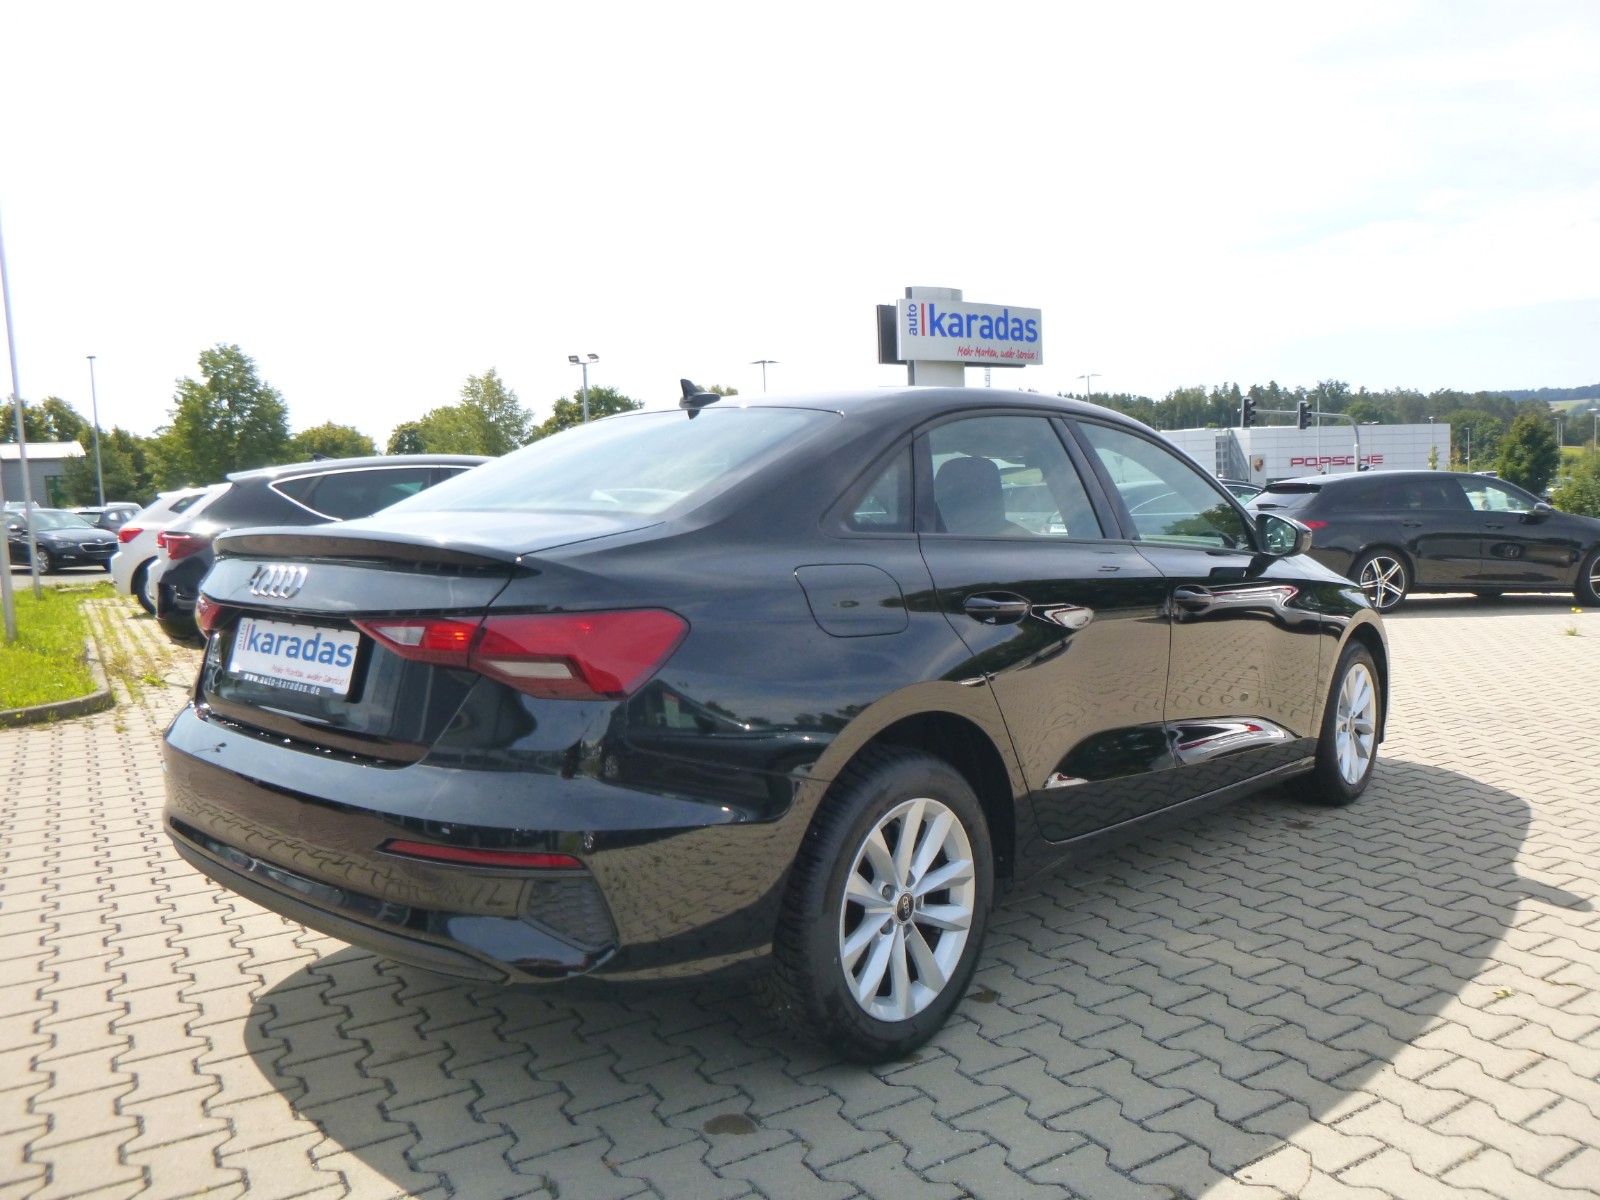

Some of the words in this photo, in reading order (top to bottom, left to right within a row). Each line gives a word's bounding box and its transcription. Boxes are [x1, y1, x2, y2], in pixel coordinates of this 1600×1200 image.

[907, 303, 917, 336] auto
[929, 303, 1038, 343] karadas
[1290, 455, 1384, 467] PORSCHE
[247, 624, 354, 667] karadas
